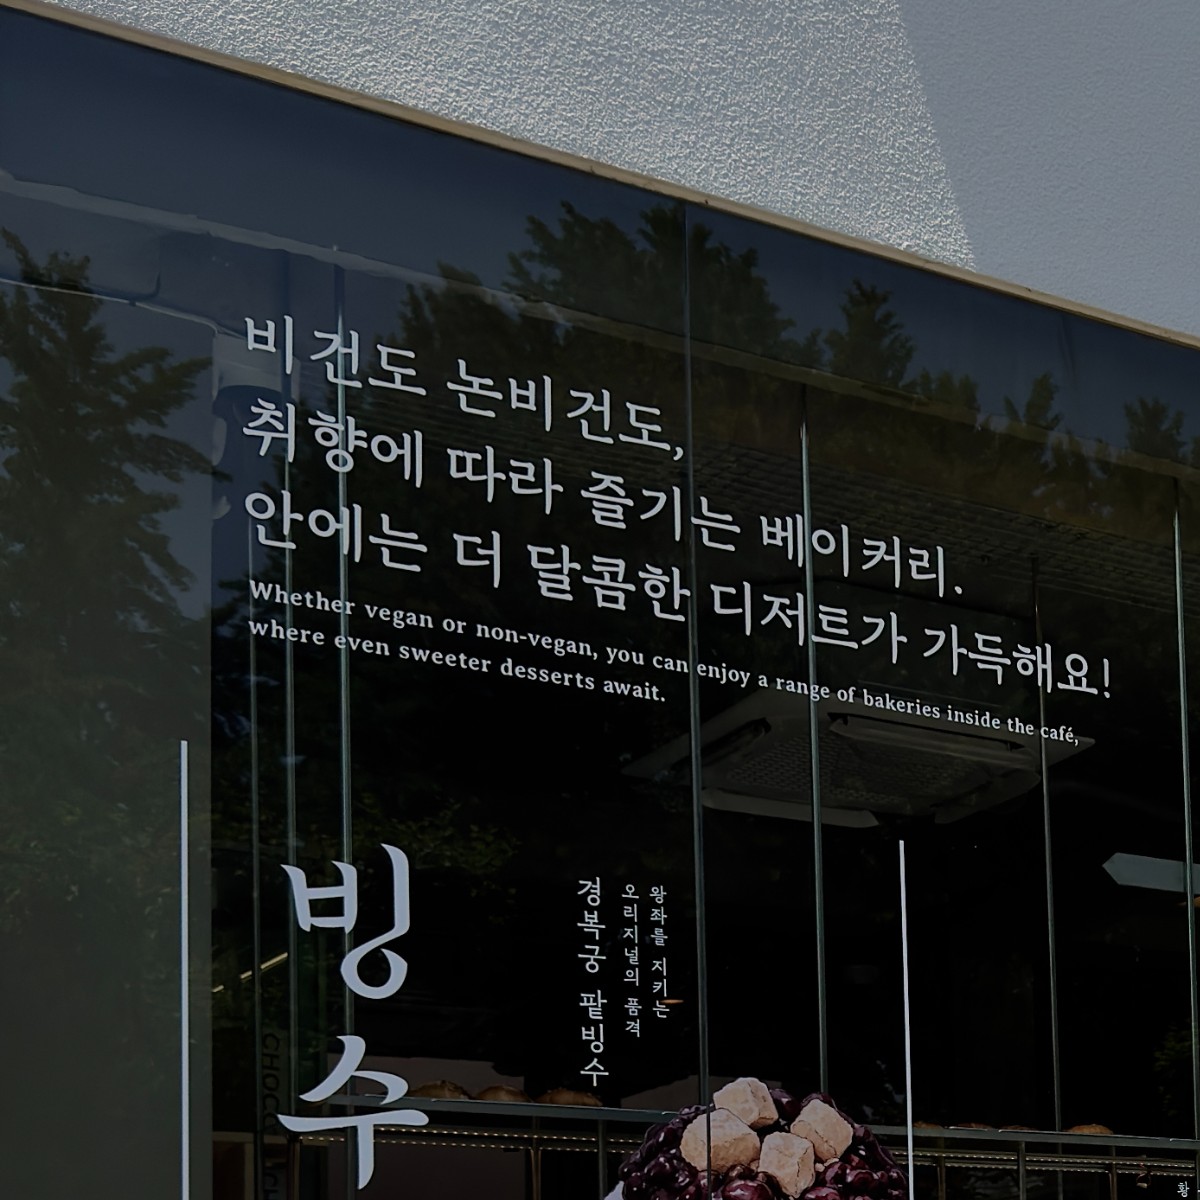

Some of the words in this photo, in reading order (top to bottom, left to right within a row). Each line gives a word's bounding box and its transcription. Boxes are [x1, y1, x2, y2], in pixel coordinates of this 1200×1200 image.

[245, 314, 427, 397] 비건도
[446, 358, 685, 461] 논비건도,
[242, 397, 424, 489] 취향에
[446, 444, 564, 515] 따라
[579, 470, 742, 552] 즐기는
[760, 512, 965, 599] 베이커리.
[244, 488, 428, 574] 안에는
[453, 529, 502, 590] 더
[526, 544, 691, 622] 달콤한
[709, 580, 909, 665] 디저트가
[922, 623, 1112, 699] 가득해요!
[248, 618, 325, 646] where
[333, 633, 390, 657] even
[398, 642, 492, 674] sweeter
[499, 656, 595, 691] desserts
[602, 677, 667, 703] await.
[248, 579, 355, 616] Whether
[364, 602, 434, 630] vegan
[442, 617, 467, 634] or
[476, 621, 599, 661] non-vegan,
[605, 645, 645, 668] you
[652, 654, 689, 673] can
[696, 659, 750, 688] enjoy
[758, 674, 769, 687] a
[775, 675, 830, 701] range
[835, 685, 857, 704] of
[863, 688, 941, 720] bakeries
[946, 704, 1001, 730] inside
[1006, 716, 1035, 737] the
[1040, 724, 1080, 747] café,
[576, 876, 607, 975] 경복궁
[621, 883, 641, 987] 오리지널의
[648, 884, 669, 947] 왕좌를
[578, 988, 610, 1088] 팥빙수
[623, 997, 643, 1038] 품격
[651, 956, 671, 1020] 지키는
